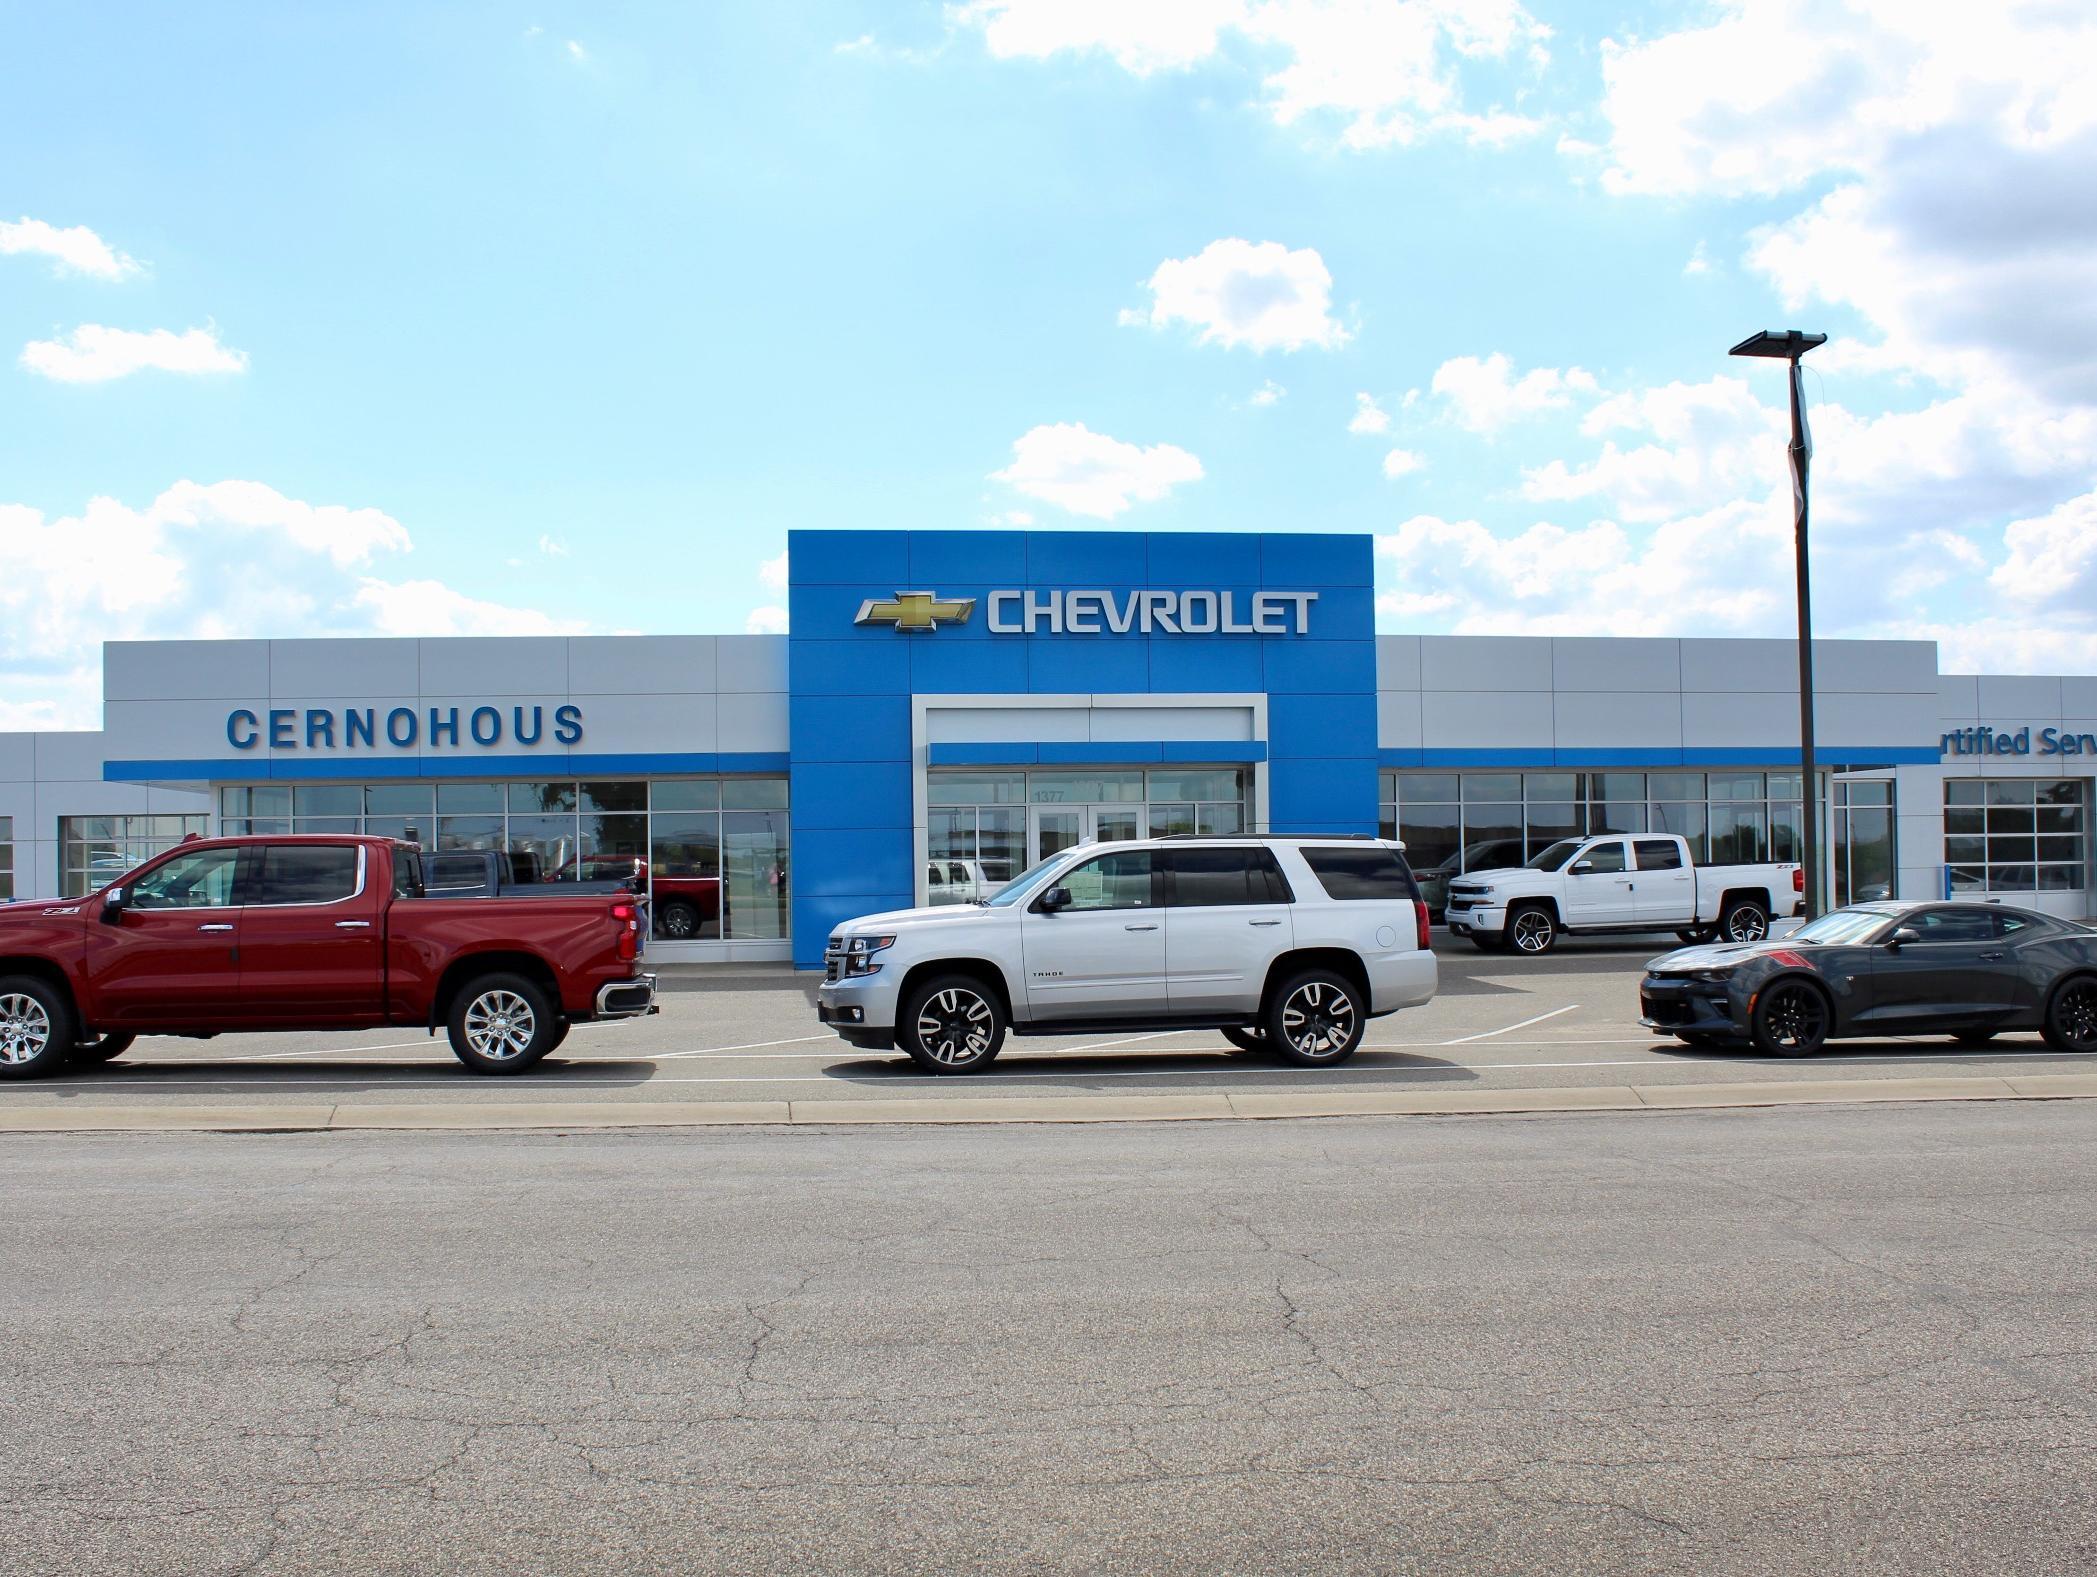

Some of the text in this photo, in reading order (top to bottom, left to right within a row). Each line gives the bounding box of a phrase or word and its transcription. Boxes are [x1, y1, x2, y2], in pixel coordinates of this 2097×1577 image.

[987, 590, 1319, 634] CHEVROLET
[226, 705, 584, 749] CERNOHOUS
[1035, 790, 1065, 803] 1377
